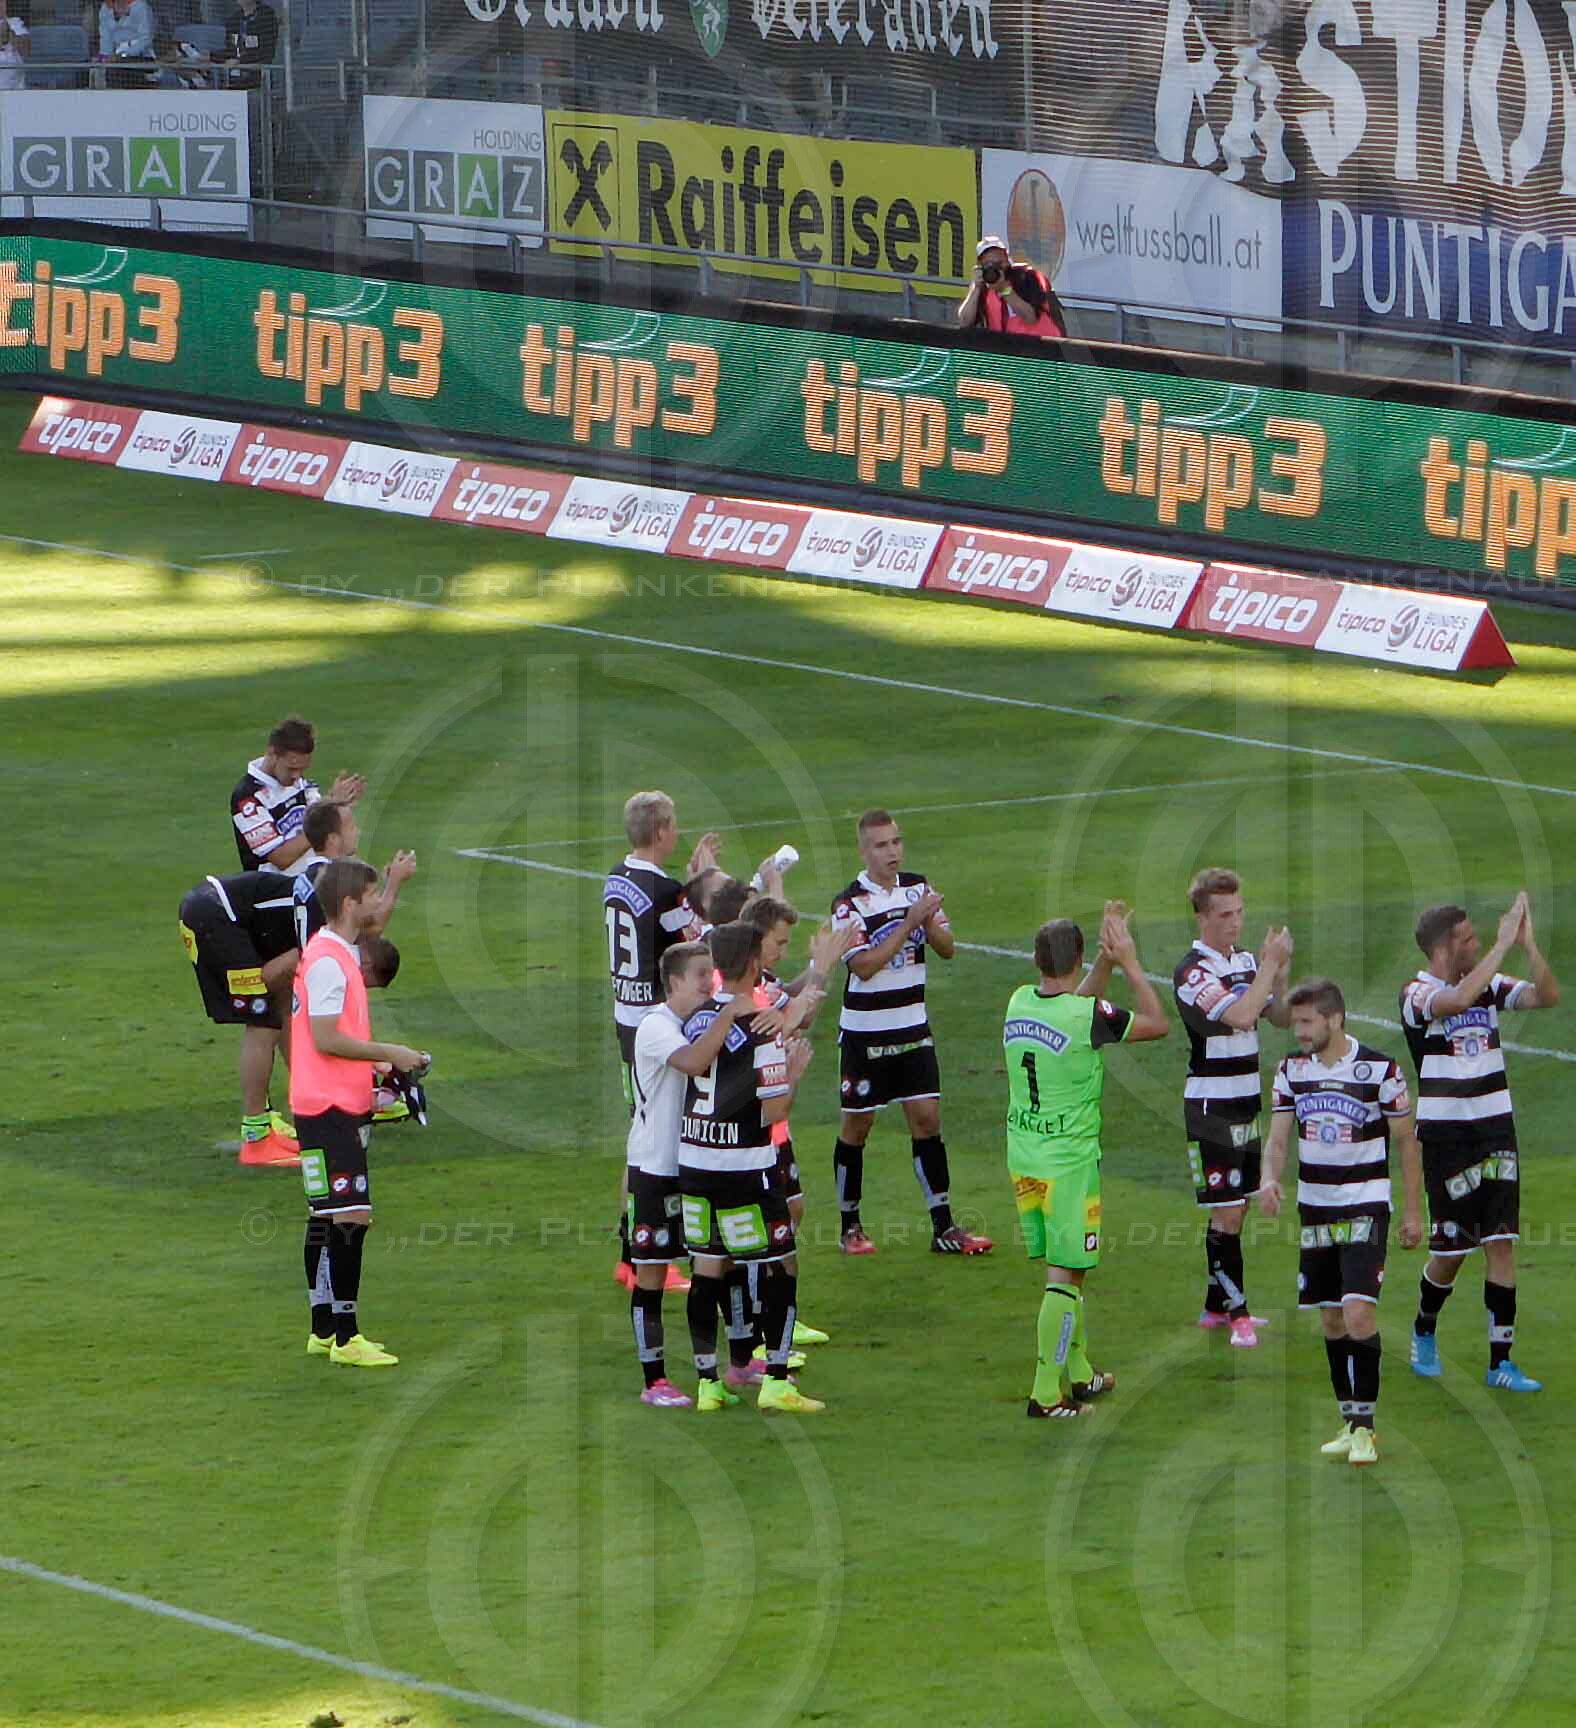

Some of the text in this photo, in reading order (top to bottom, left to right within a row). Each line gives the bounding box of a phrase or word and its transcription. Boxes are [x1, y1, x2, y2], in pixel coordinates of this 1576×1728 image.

[149, 113, 237, 133] HOLDING
[473, 129, 543, 153] HOLDING
[19, 142, 226, 190] GRAZ
[372, 154, 536, 215] GRAZ
[636, 139, 965, 278] Raiffeisen
[1075, 207, 1263, 272] weltfussball.at
[254, 290, 445, 411] tipp3
[520, 325, 718, 446] tipp3
[38, 413, 123, 454] tipico
[133, 431, 167, 454] tipico
[804, 362, 1014, 488] tipp3
[188, 445, 224, 469] LIGA
[240, 432, 329, 487] tipico
[342, 462, 382, 487] tipico
[1099, 401, 1326, 530] tipp3
[401, 477, 439, 503] LIGA
[452, 467, 551, 522] tipico
[565, 496, 609, 522] tipico
[633, 512, 671, 539] LIGA
[688, 500, 789, 557] tipico
[808, 530, 850, 556] tipico
[878, 545, 919, 573] LIGA
[946, 536, 1050, 595] tipico
[1063, 566, 1110, 596] tipico
[1135, 587, 1178, 614] LIGA
[1208, 576, 1318, 634] tipico
[1337, 606, 1386, 634] tipico
[1413, 625, 1460, 656] LIGA
[605, 906, 639, 978] 13
[1021, 1051, 1040, 1114] 1
